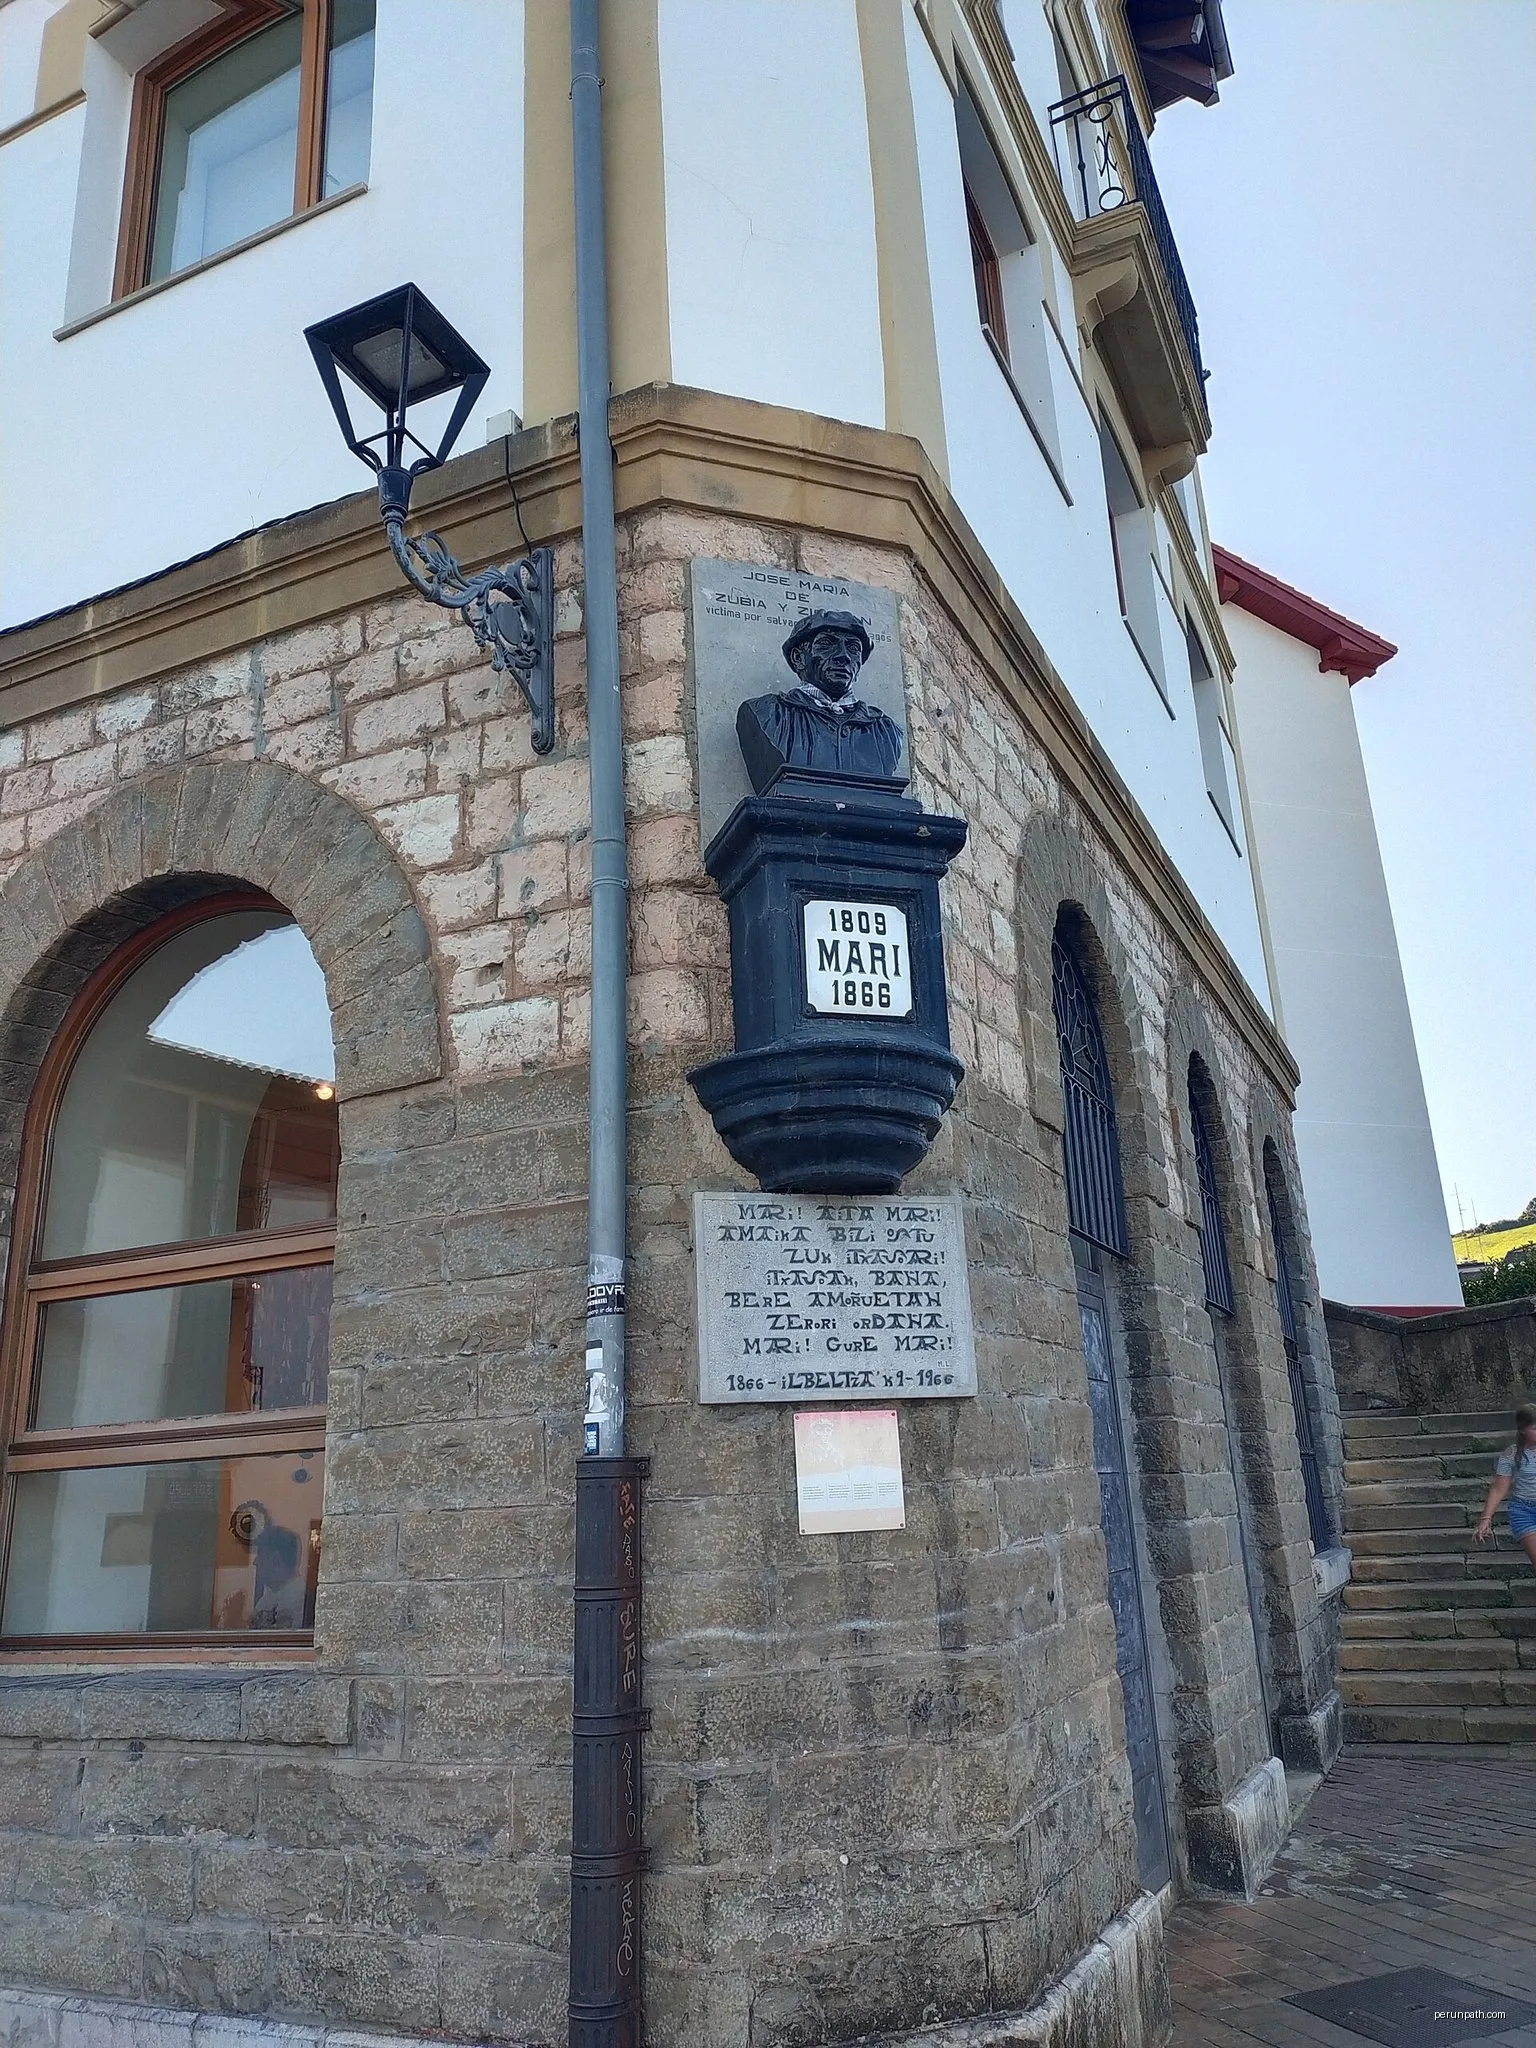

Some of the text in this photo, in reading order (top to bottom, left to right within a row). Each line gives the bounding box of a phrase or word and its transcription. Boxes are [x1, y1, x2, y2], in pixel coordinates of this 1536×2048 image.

[743, 571, 849, 597] JOSE MARIA
[785, 590, 810, 603] DE
[715, 593, 788, 612] ZUBIA Y
[744, 612, 762, 622] por
[829, 908, 887, 936] 1809
[816, 938, 902, 981] MARI
[831, 979, 891, 1008] 1866
